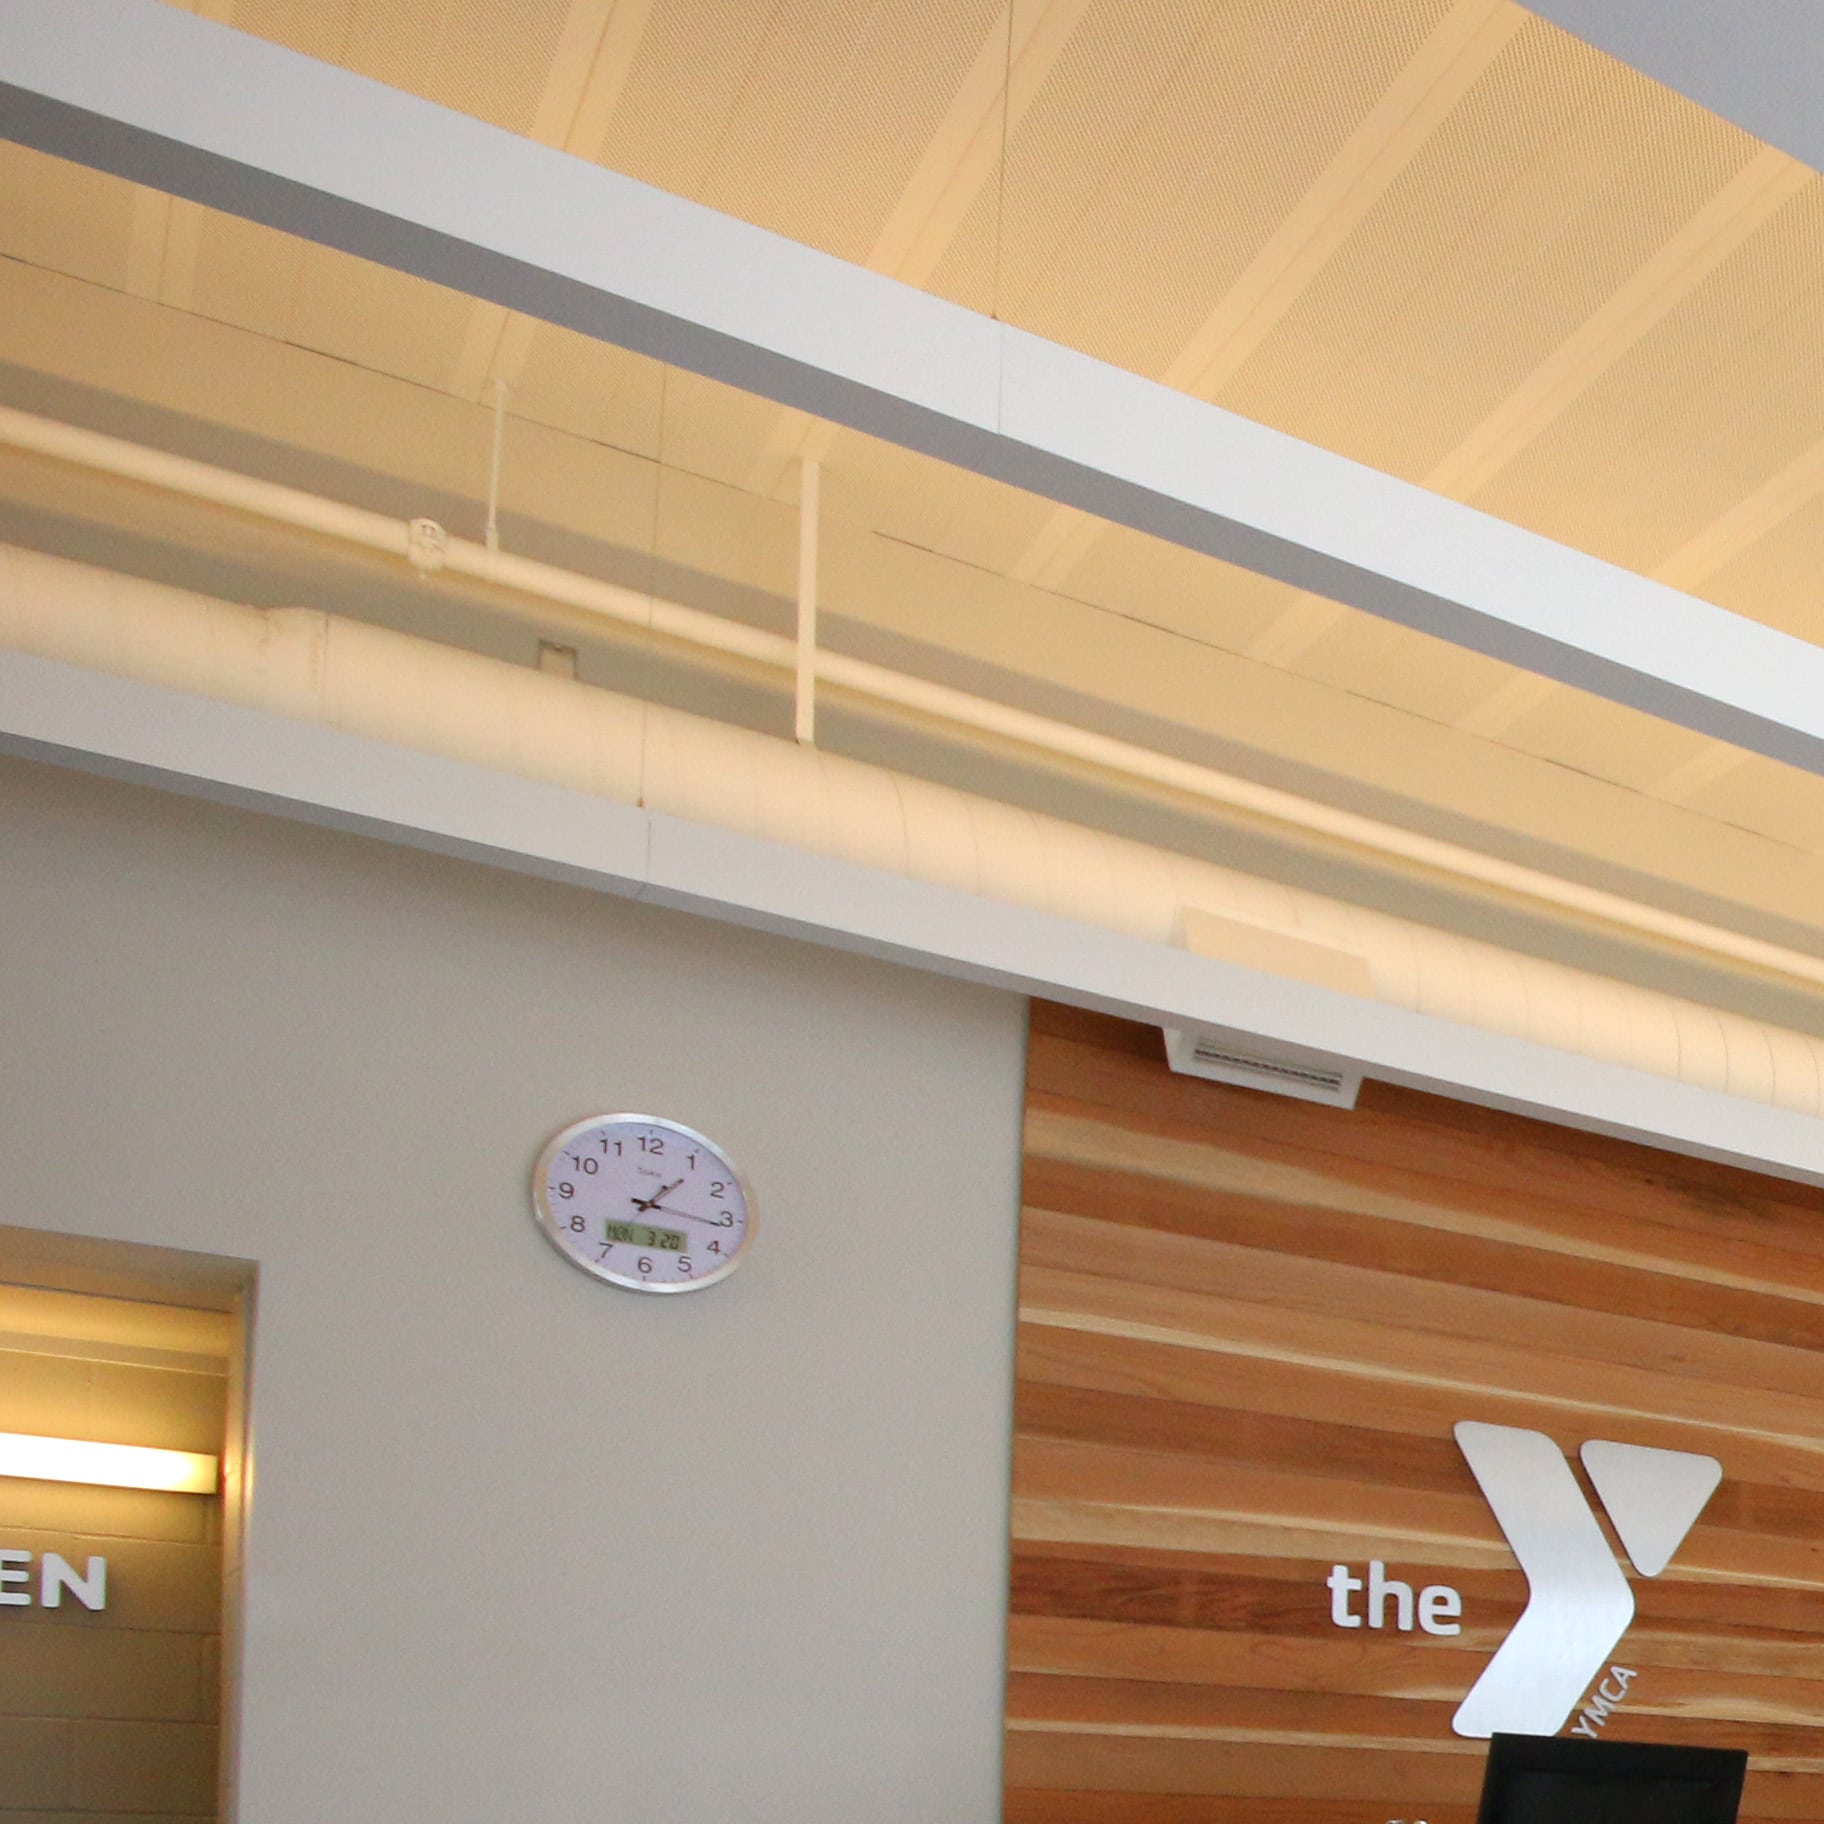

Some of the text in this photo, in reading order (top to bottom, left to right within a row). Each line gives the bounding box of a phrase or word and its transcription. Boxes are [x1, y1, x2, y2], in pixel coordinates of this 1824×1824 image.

[600, 1138, 622, 1157] 11
[637, 1136, 664, 1156] 12
[572, 1156, 599, 1175] 10
[686, 1154, 696, 1171] 1
[559, 1182, 574, 1199] 9
[710, 1181, 725, 1198] 2
[570, 1215, 586, 1233] 8
[720, 1211, 734, 1227] 3
[599, 1242, 613, 1259] 7
[707, 1240, 721, 1254] 4
[637, 1256, 652, 1274] 6
[678, 1256, 692, 1273] 5
[1326, 1560, 1462, 1636] the
[1571, 1664, 1639, 1739] YMCA
